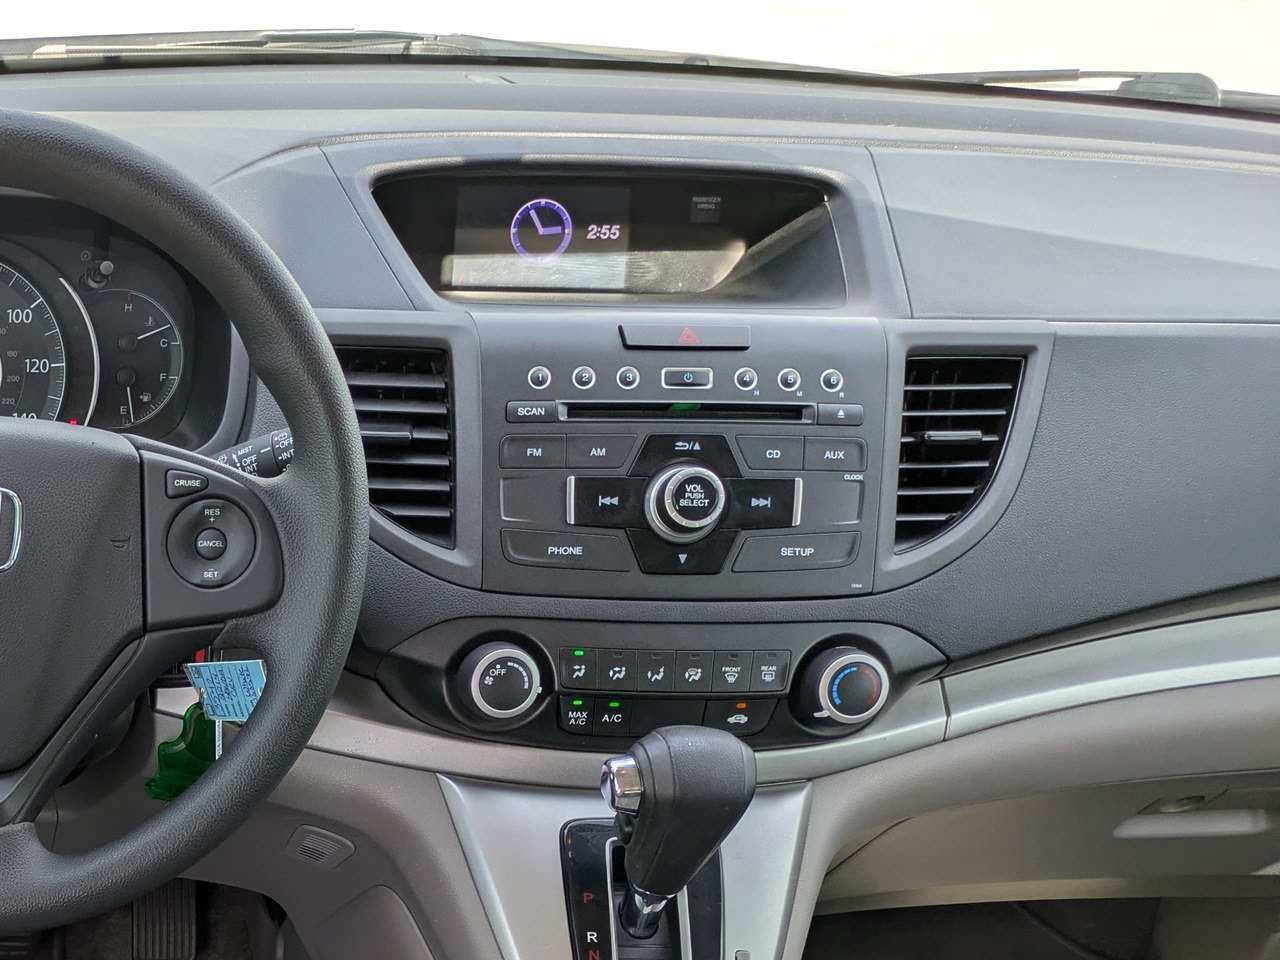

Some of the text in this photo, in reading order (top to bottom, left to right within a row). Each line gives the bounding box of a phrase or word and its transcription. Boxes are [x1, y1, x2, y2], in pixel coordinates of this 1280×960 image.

[586, 224, 621, 240] 2:55
[125, 303, 133, 312] H
[7, 308, 33, 324] 100
[160, 338, 168, 348] C
[25, 358, 50, 373] 120
[160, 373, 168, 382] F
[582, 373, 589, 382] 2
[626, 373, 633, 382] 3
[743, 374, 750, 382] 4
[787, 375, 794, 384] 5
[830, 376, 838, 385] 6
[120, 405, 128, 415] E
[517, 407, 545, 416] SCAN
[526, 447, 542, 457] FM
[590, 447, 606, 457] AM
[766, 449, 781, 459] CD
[824, 450, 845, 459] AUX
[241, 454, 257, 467] OFF
[174, 479, 201, 487] CRUISE
[685, 483, 704, 493] VOL
[679, 499, 710, 507] SELECT
[204, 508, 221, 516] RES
[198, 540, 224, 548] CANCEL
[547, 546, 583, 556] PHONE
[780, 547, 815, 557] SETUP
[489, 668, 507, 677] OFF
[568, 711, 588, 719] MAX
[601, 714, 622, 723] A/C
[569, 718, 587, 726] A/C
[583, 892, 594, 904] P
[586, 931, 598, 943] R
[589, 950, 600, 960] N
